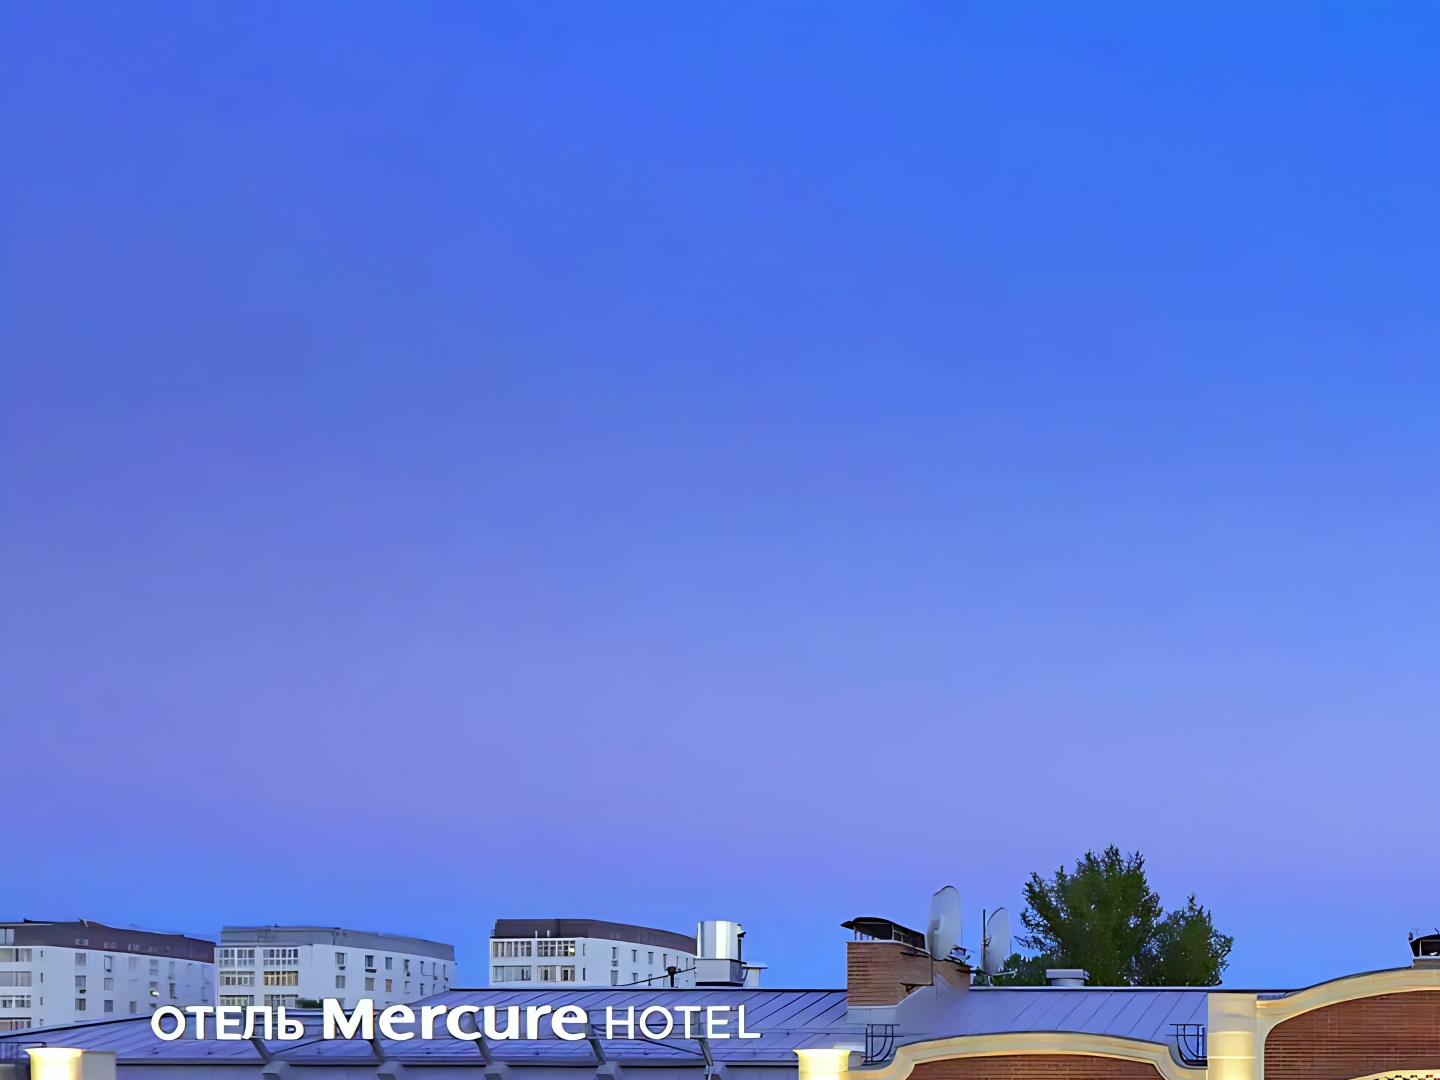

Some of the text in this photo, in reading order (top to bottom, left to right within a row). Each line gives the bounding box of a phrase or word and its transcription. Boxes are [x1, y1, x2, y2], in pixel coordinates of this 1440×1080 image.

[151, 998, 761, 1041] ОТЕЛЬ Mercure HOTEL
